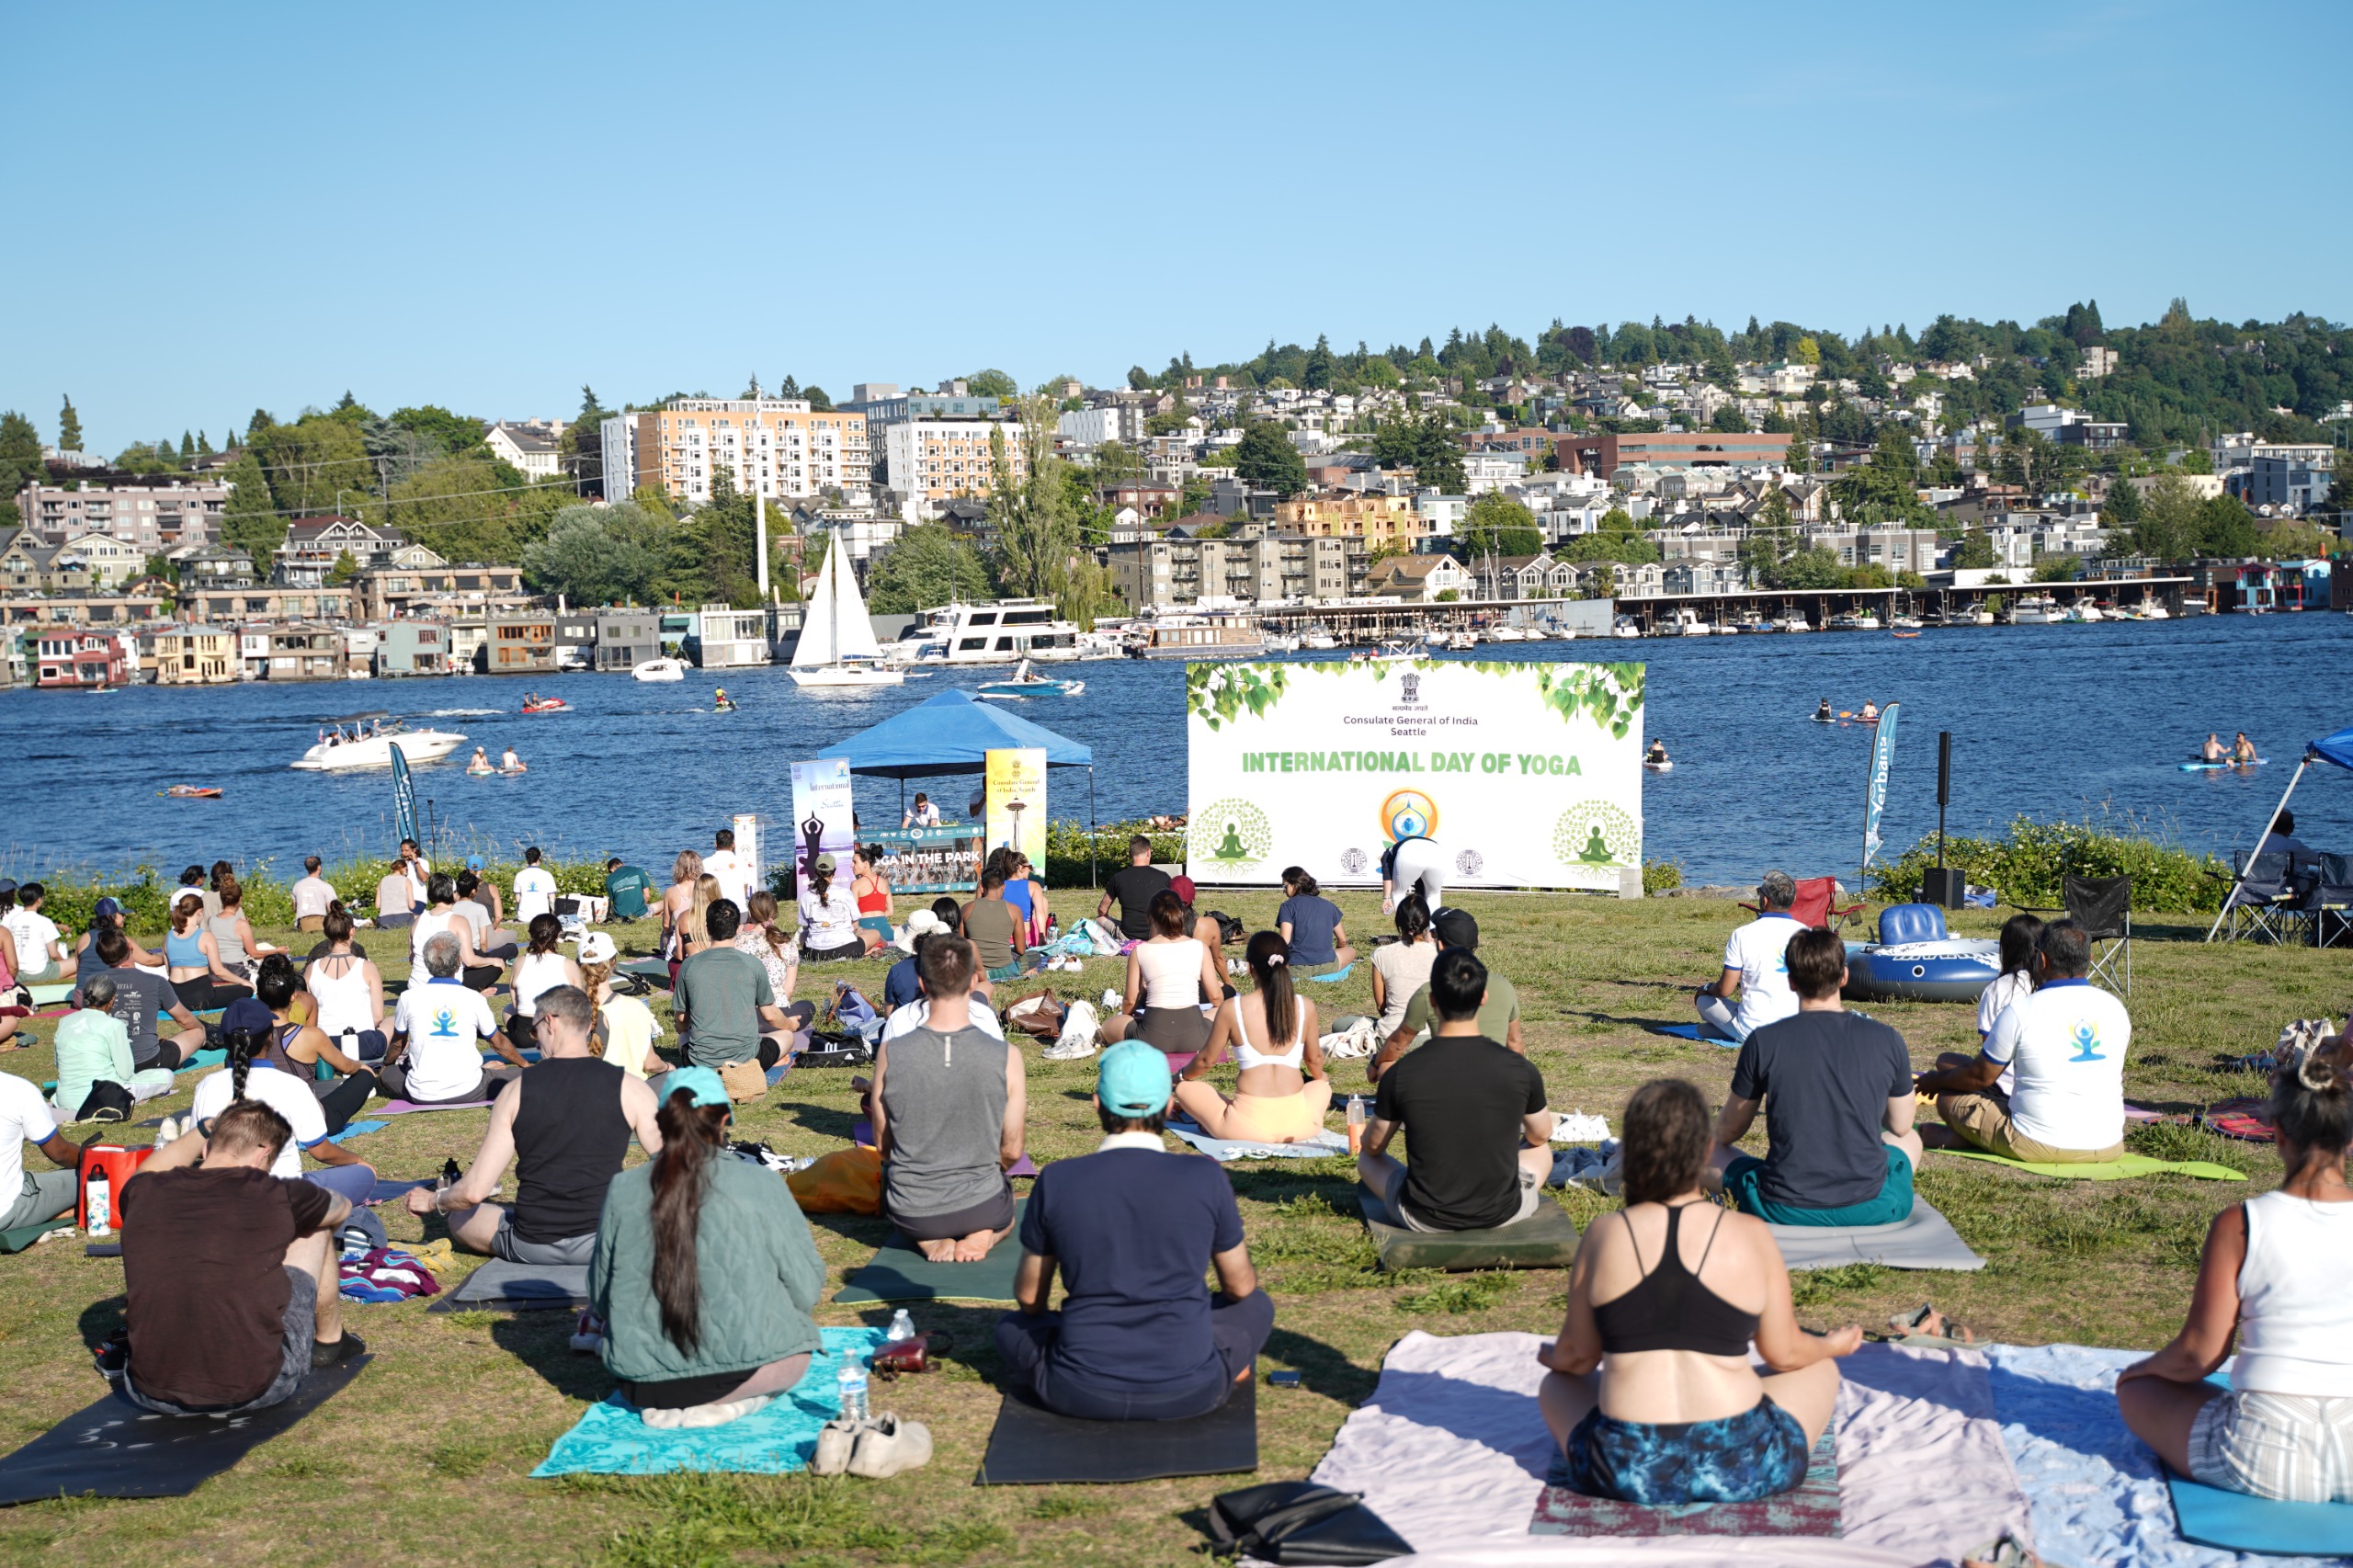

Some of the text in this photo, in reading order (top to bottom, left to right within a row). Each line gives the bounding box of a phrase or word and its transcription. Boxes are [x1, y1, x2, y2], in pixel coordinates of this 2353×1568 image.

[1343, 715, 1478, 726] Consulate General of India
[1391, 727, 1427, 736] Seattle
[1242, 751, 1582, 777] INTERNATIONAL DAY OF YOGA
[1871, 736, 1888, 816] Yerbana
[809, 779, 850, 791] International
[901, 854, 915, 865] IN
[915, 852, 943, 864] THE
[945, 850, 982, 863] PARK
